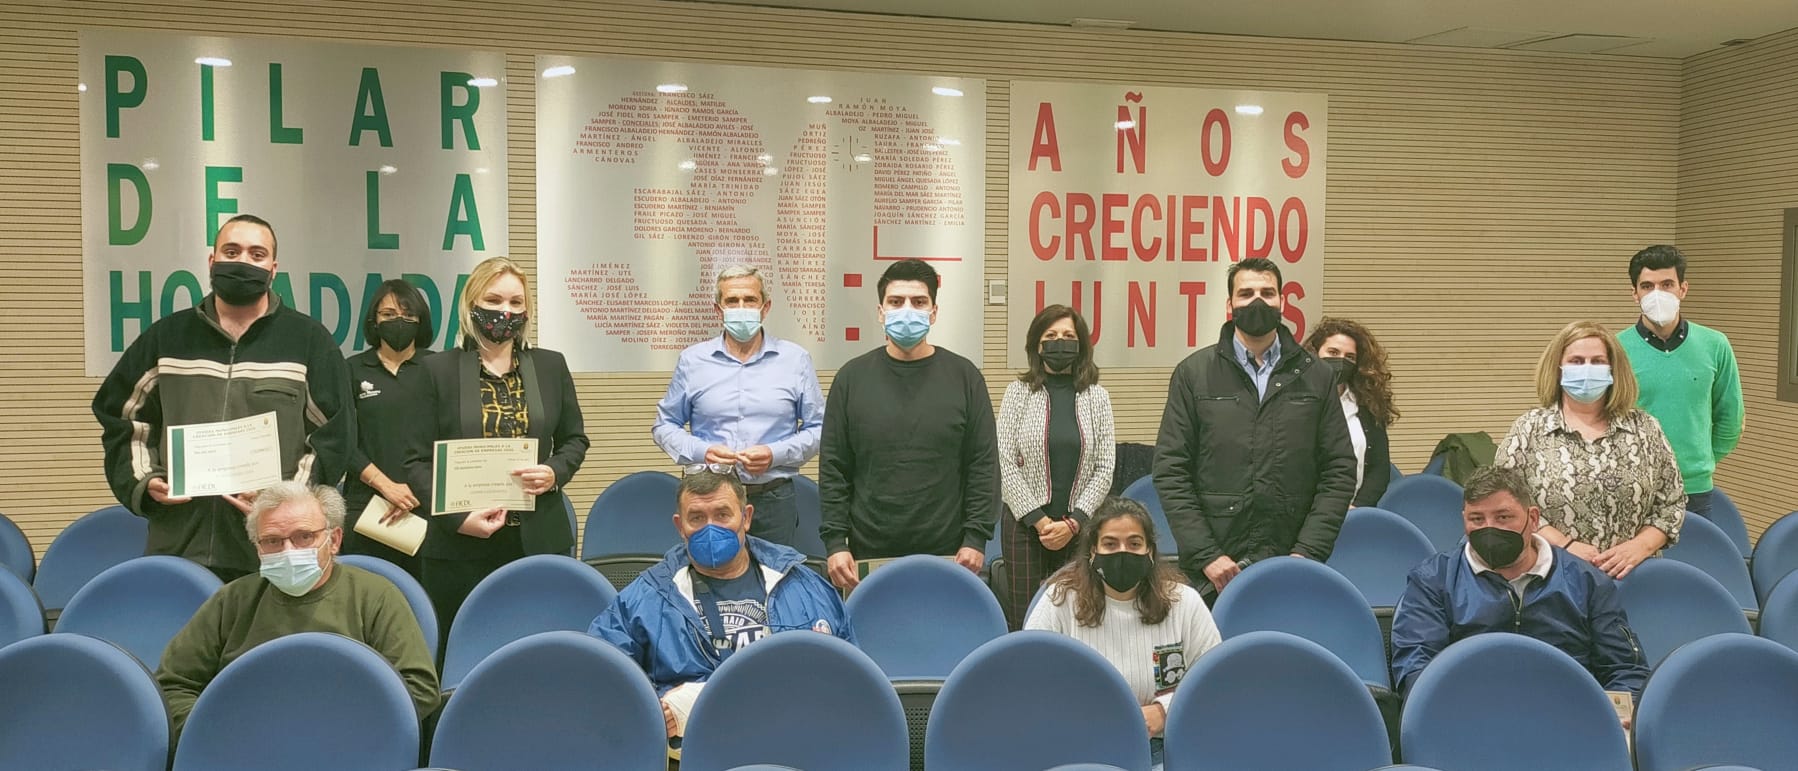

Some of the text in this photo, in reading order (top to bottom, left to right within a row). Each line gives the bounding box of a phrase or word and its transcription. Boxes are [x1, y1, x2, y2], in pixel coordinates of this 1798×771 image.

[104, 54, 481, 150] PILAR
[631, 134, 656, 142] ÁNGEL
[1028, 91, 1310, 178] AÑOS
[107, 163, 243, 247] DE
[366, 171, 485, 251] LA
[1028, 191, 1309, 263] CRECIENDO
[1035, 281, 1306, 347] UNTS
